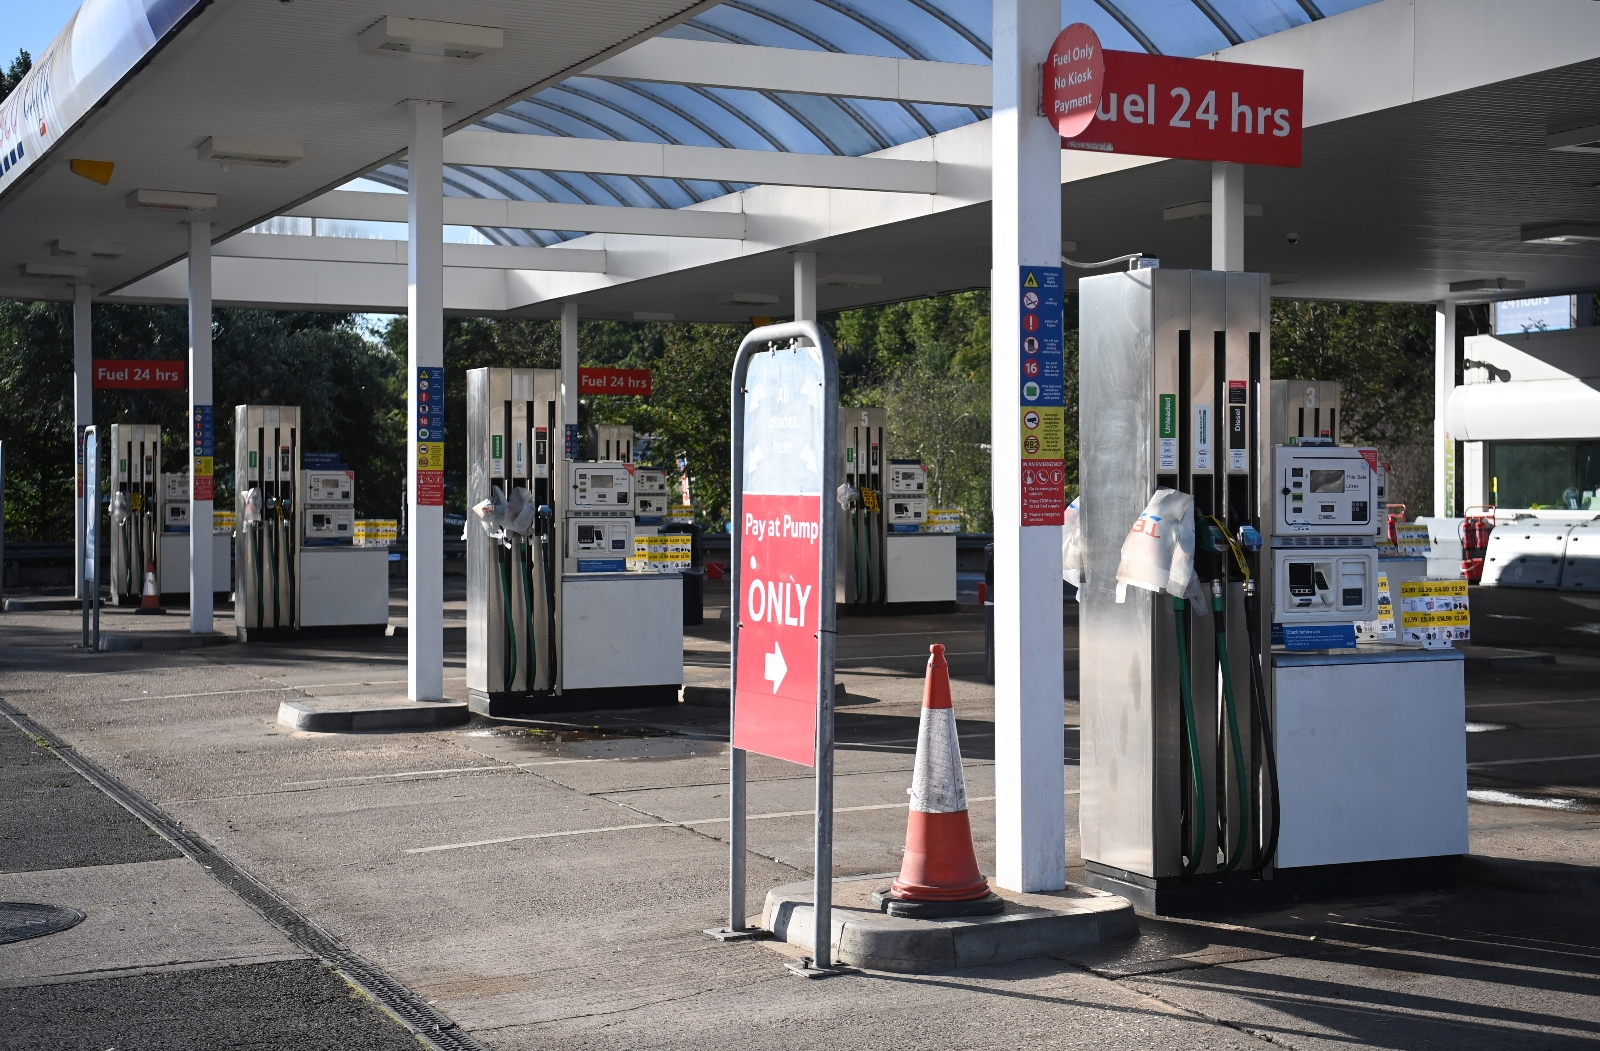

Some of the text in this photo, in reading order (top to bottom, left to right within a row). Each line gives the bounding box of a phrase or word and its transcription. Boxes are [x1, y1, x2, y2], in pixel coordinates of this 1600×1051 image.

[1053, 44, 1094, 67] Fuel Only
[1054, 67, 1093, 90] No Kiosk
[1054, 92, 1093, 114] Payment
[1096, 83, 1291, 137] uel 24 hrs
[98, 367, 179, 381] Fuel 24 hrs
[1026, 363, 1038, 374] 16
[581, 375, 647, 388] Fuel 24 hrs
[776, 387, 789, 404] All
[1306, 386, 1316, 408] 3
[768, 412, 797, 434] grades
[861, 411, 869, 427] 5
[612, 428, 618, 440] 7
[772, 438, 792, 455] here
[1445, 438, 1453, 518] OMENTUM
[745, 512, 819, 545] Pay at Pump
[748, 578, 812, 628] ONLY
